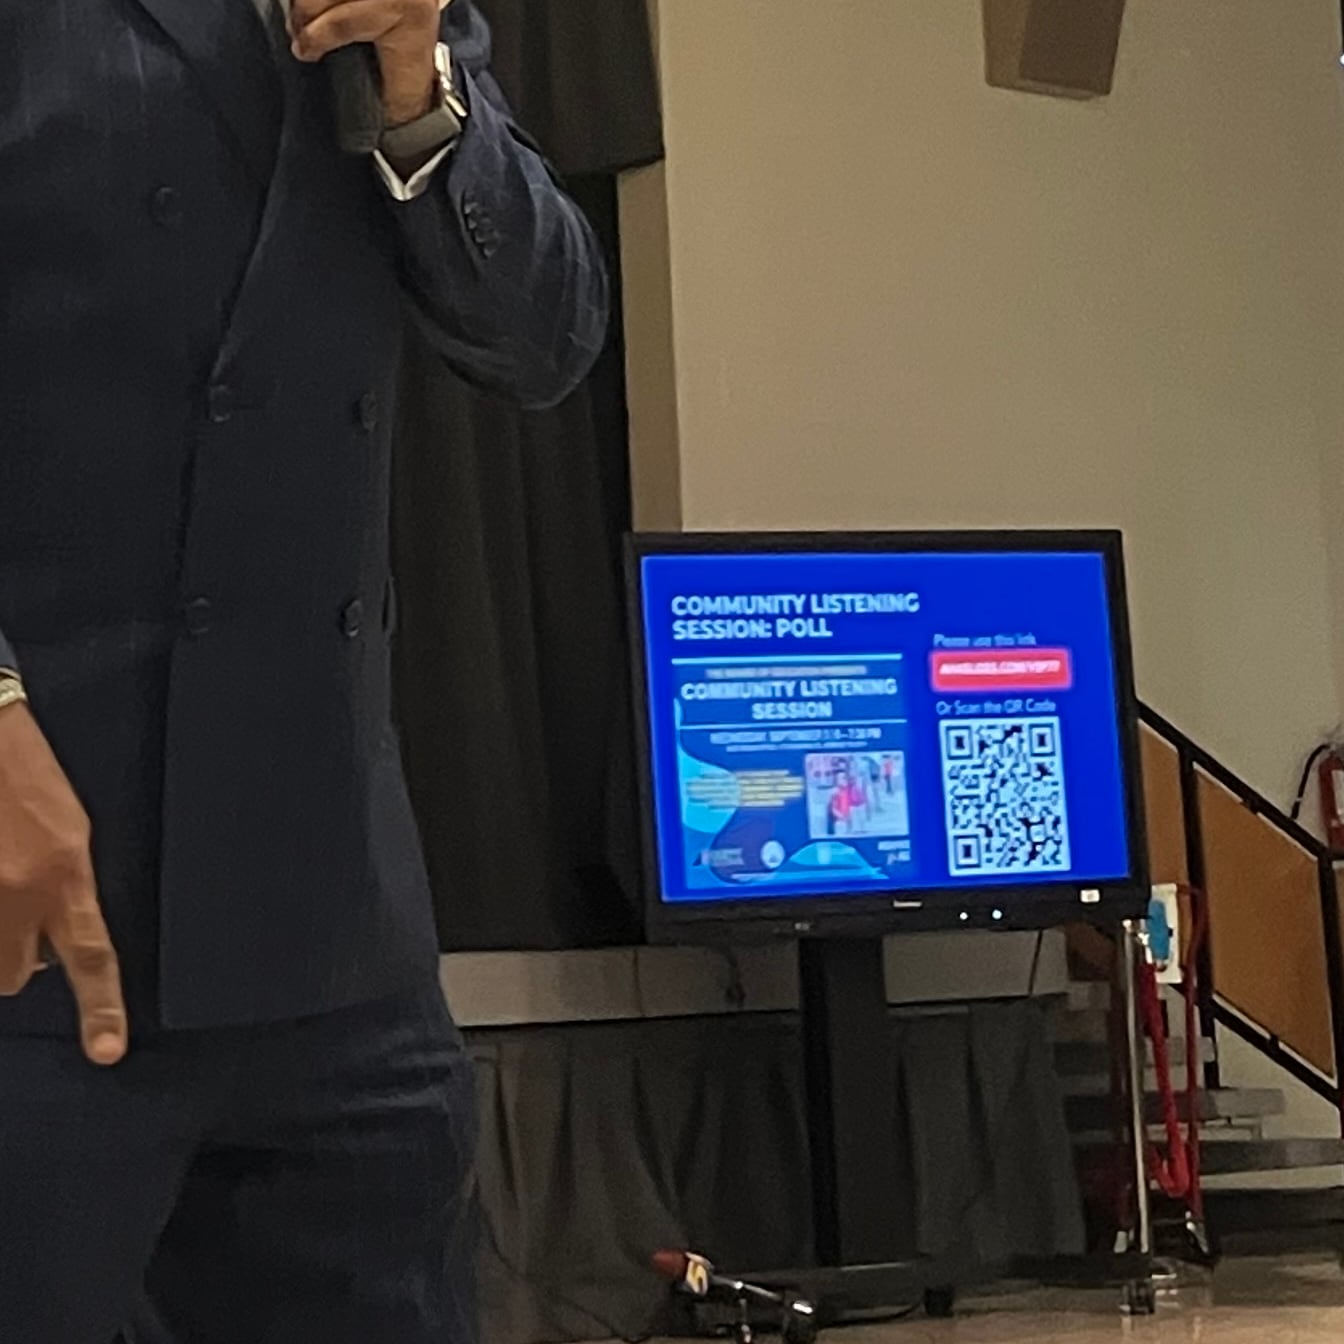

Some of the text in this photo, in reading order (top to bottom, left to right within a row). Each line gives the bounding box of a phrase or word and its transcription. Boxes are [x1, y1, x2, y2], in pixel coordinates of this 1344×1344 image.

[671, 593, 920, 616] COMMUNITY LISTENING
[672, 618, 833, 640] SESSION: POLL
[681, 678, 897, 700] COMMUNITY LISTENING
[752, 701, 832, 720] SESSION
